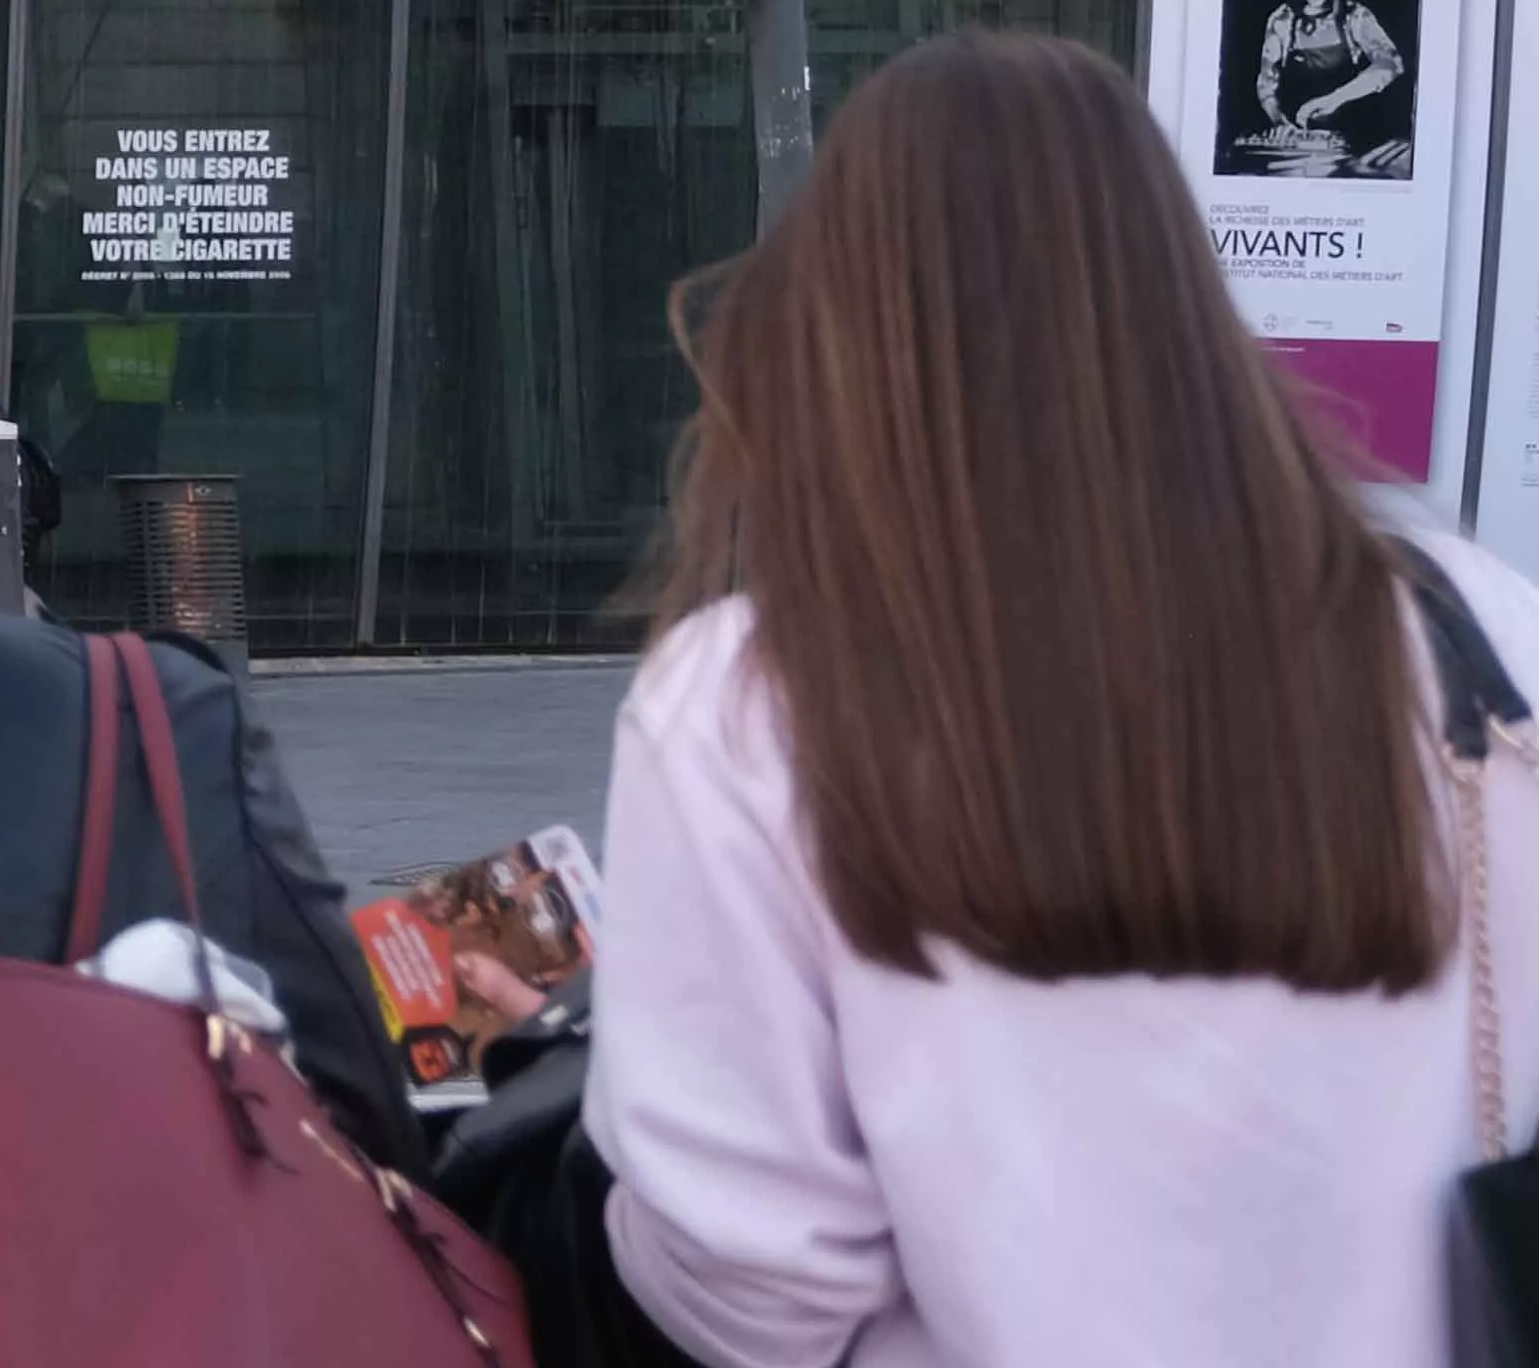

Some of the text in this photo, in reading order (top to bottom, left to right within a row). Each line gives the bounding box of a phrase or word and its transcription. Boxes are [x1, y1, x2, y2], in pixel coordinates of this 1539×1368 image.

[117, 129, 271, 152] VOUS ENTREZ
[95, 156, 290, 180] DANS UN ESPACE
[116, 184, 270, 208] NON-FUMEUR
[82, 206, 295, 234] MERCI D'ÉTEINDRE
[90, 238, 292, 262] VOTRE CIGARETTE
[1209, 228, 1364, 259] VIVANTS !
